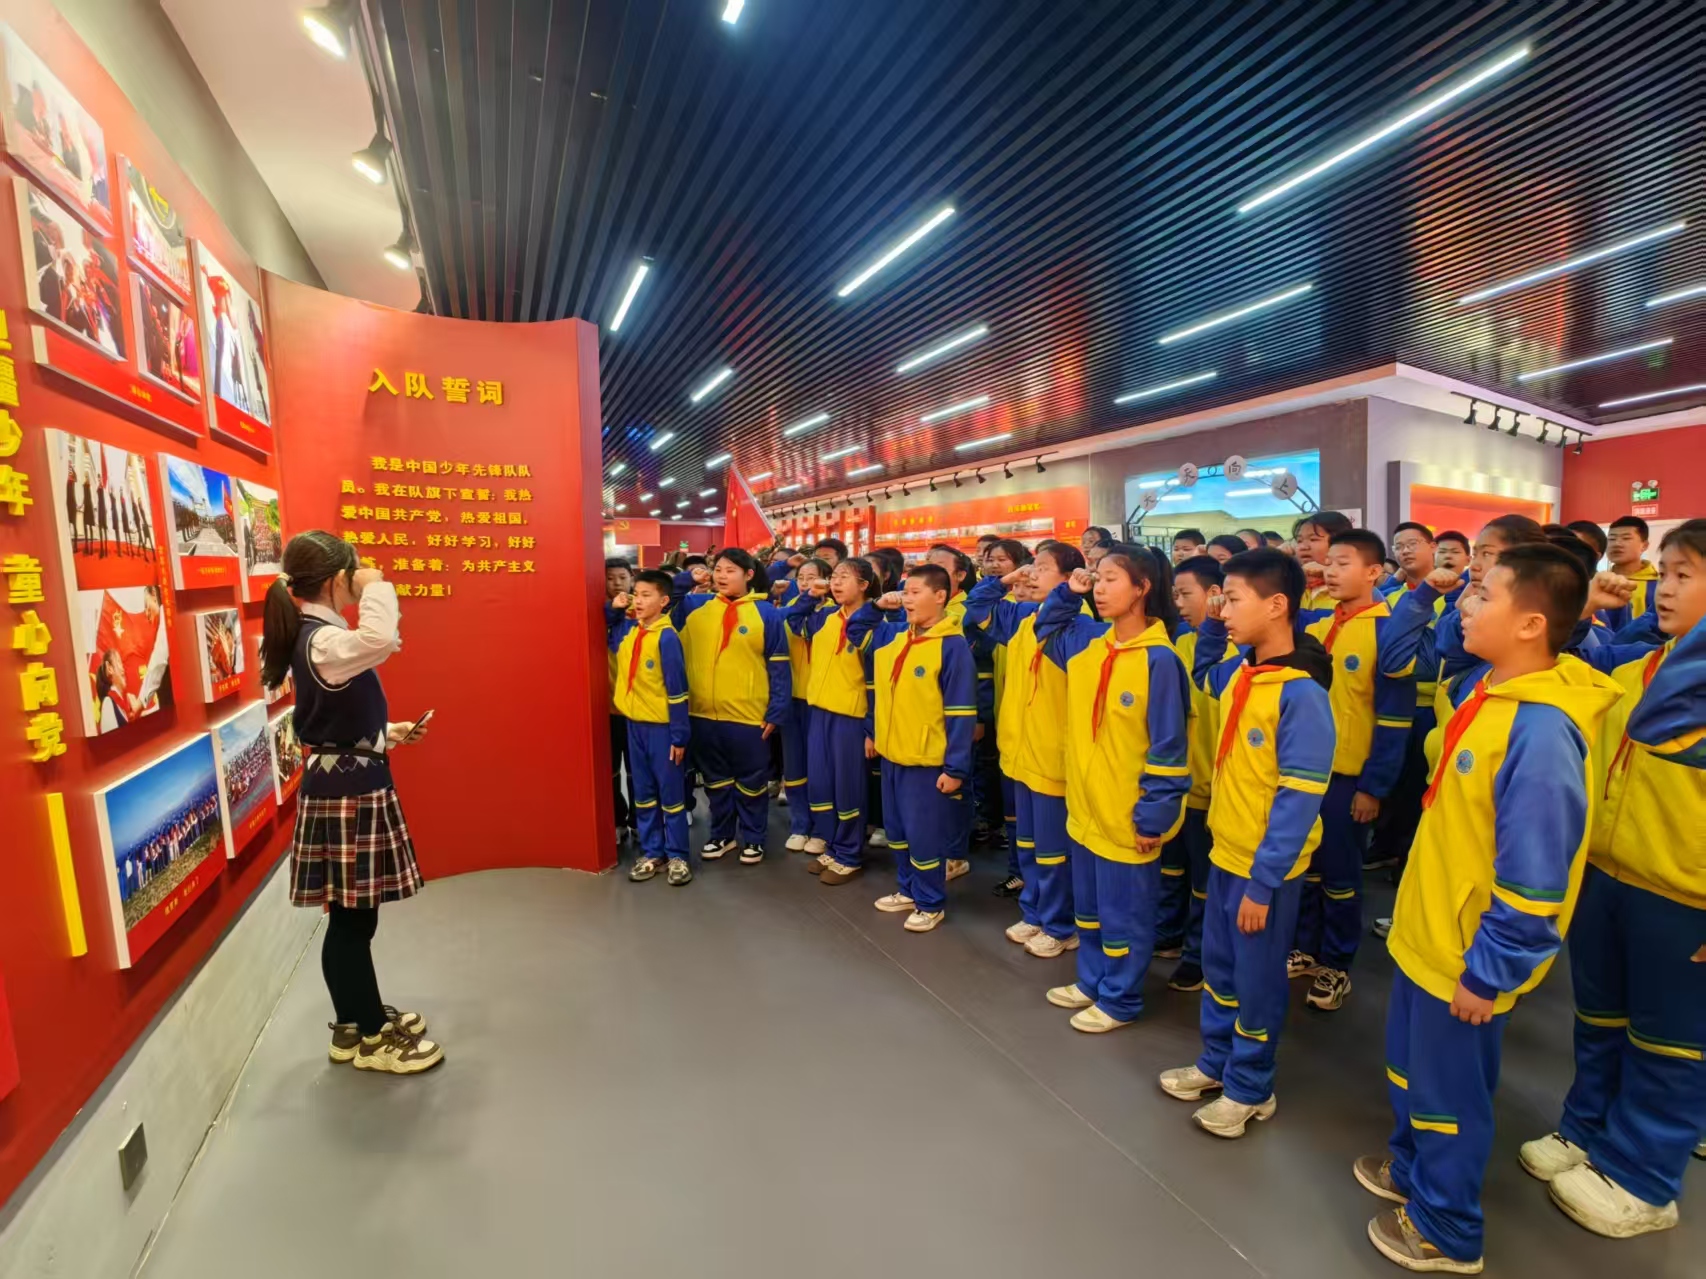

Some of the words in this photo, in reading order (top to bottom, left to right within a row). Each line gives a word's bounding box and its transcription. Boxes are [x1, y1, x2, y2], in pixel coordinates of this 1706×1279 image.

[0, 309, 33, 516] 少年
[368, 367, 504, 405] 入队誓词
[371, 456, 531, 478] 我是中国少年先锋队队
[2, 553, 67, 762] 童心向党
